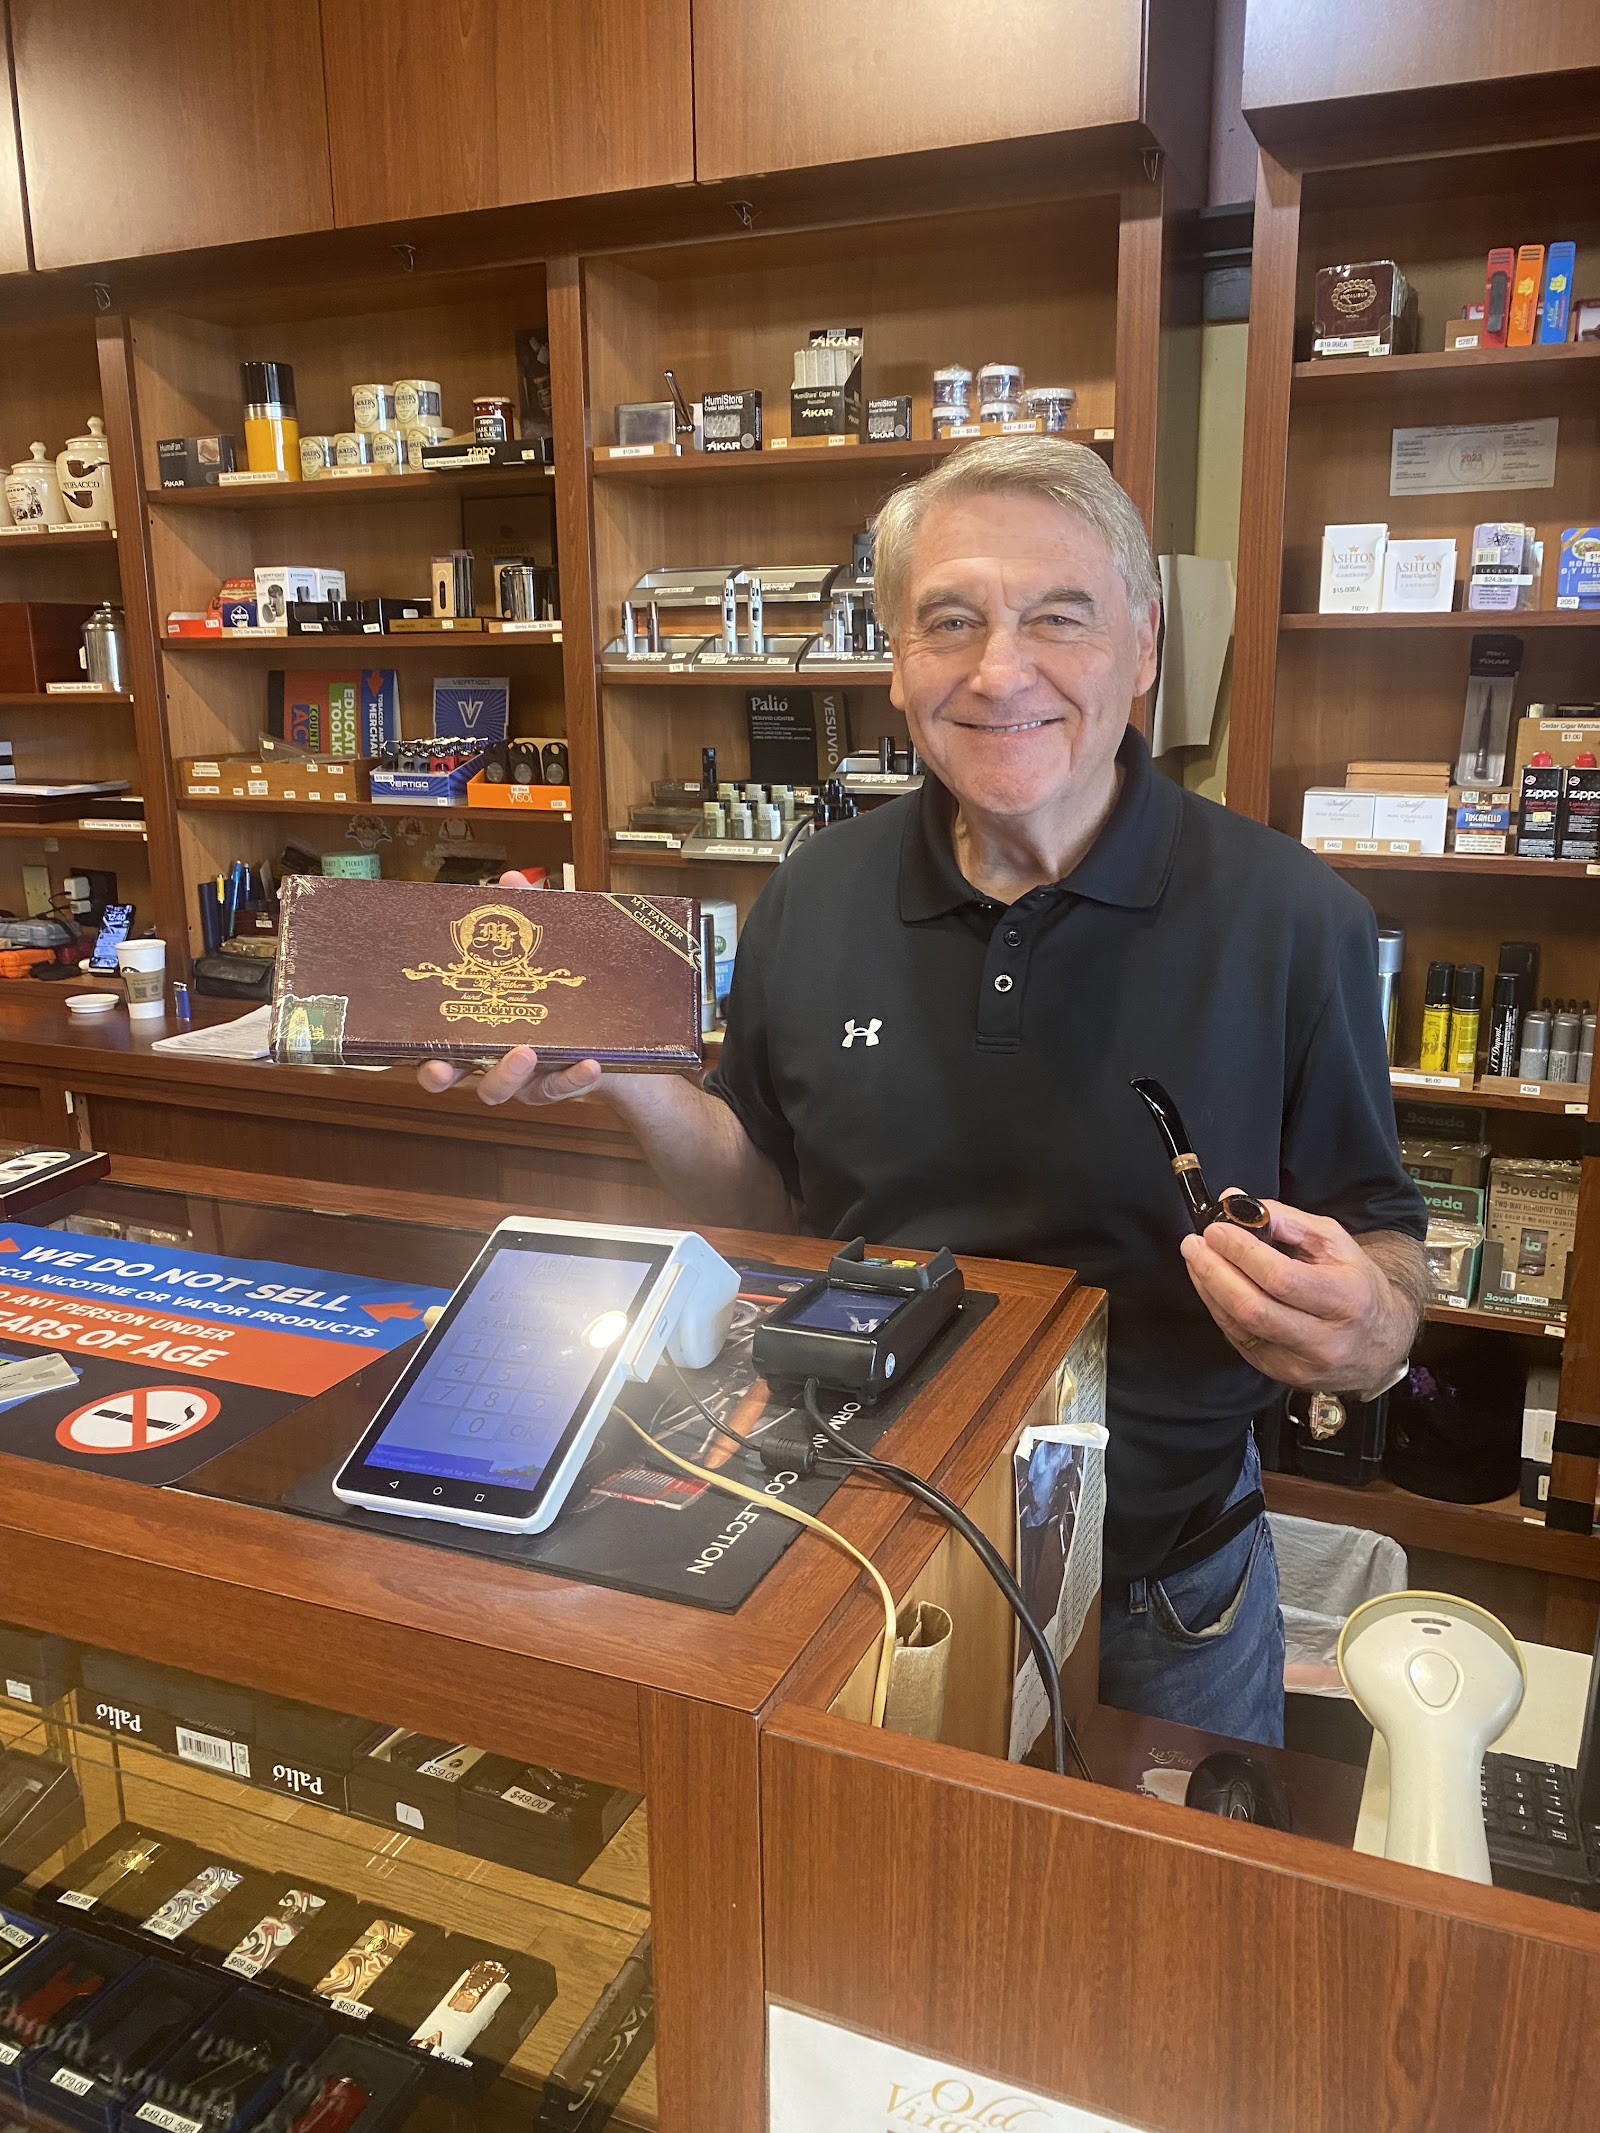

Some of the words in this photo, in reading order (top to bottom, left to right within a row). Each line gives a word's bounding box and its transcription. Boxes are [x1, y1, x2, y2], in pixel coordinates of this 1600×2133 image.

[705, 394, 743, 405] HumiStore
[819, 391, 831, 399] Cigar
[467, 446, 496, 457] zippo
[1461, 454, 1483, 462] 2023
[63, 481, 100, 489] TOBACCO
[1332, 552, 1375, 564] ASHTON
[1397, 561, 1441, 573] ASHTON
[344, 689, 356, 754] EDUCATI
[369, 703, 380, 757] MERCHAN
[823, 696, 839, 765] VESUVIO
[1525, 789, 1559, 800] zippo
[1465, 812, 1502, 822] TOSCANELLO
[631, 897, 648, 911] MY
[648, 909, 684, 940] FATHER
[633, 910, 670, 940] CIGARS
[472, 979, 491, 990] My
[495, 980, 527, 989] Father
[450, 1004, 537, 1016] SELECTION
[1406, 1111, 1465, 1129] Boveda
[1496, 1181, 1559, 1201] Boveda
[1494, 1200, 1521, 1211] TWO-WAY
[1523, 1203, 1553, 1214] HUMIDITY
[19, 1246, 95, 1272] WE
[83, 1256, 156, 1279] DO
[152, 1267, 254, 1297] NOT
[245, 1283, 352, 1313] SELL
[33, 1273, 133, 1299] NICOTINE
[136, 1289, 172, 1303] OR
[172, 1296, 250, 1318] VAPOR
[251, 1310, 380, 1340] PRODUCTS
[12, 1294, 57, 1312] ANY
[54, 1301, 158, 1328] PERSON
[148, 1317, 237, 1343] UNDER
[76, 1327, 146, 1351] OF
[129, 1341, 231, 1369] AGE
[454, 1362, 469, 1377] 4
[500, 1368, 514, 1382] 5
[439, 1386, 456, 1401] 7
[484, 1392, 500, 1408] 8
[469, 1417, 485, 1433] 0
[510, 1424, 535, 1440] OK
[686, 1470, 798, 1574] COLECTION
[424, 1764, 461, 1782] $59.00
[510, 1790, 547, 1810] $49.00
[63, 1893, 92, 1906] $69.99
[1, 1927, 29, 1945] $59.00
[150, 1918, 178, 1936] $69.99
[227, 1956, 258, 1975] $69.99
[336, 2000, 369, 2019] $69.99
[56, 2073, 88, 2093] $79.00
[931, 2079, 1054, 2132] Old
[140, 2106, 174, 2127] $49.00
